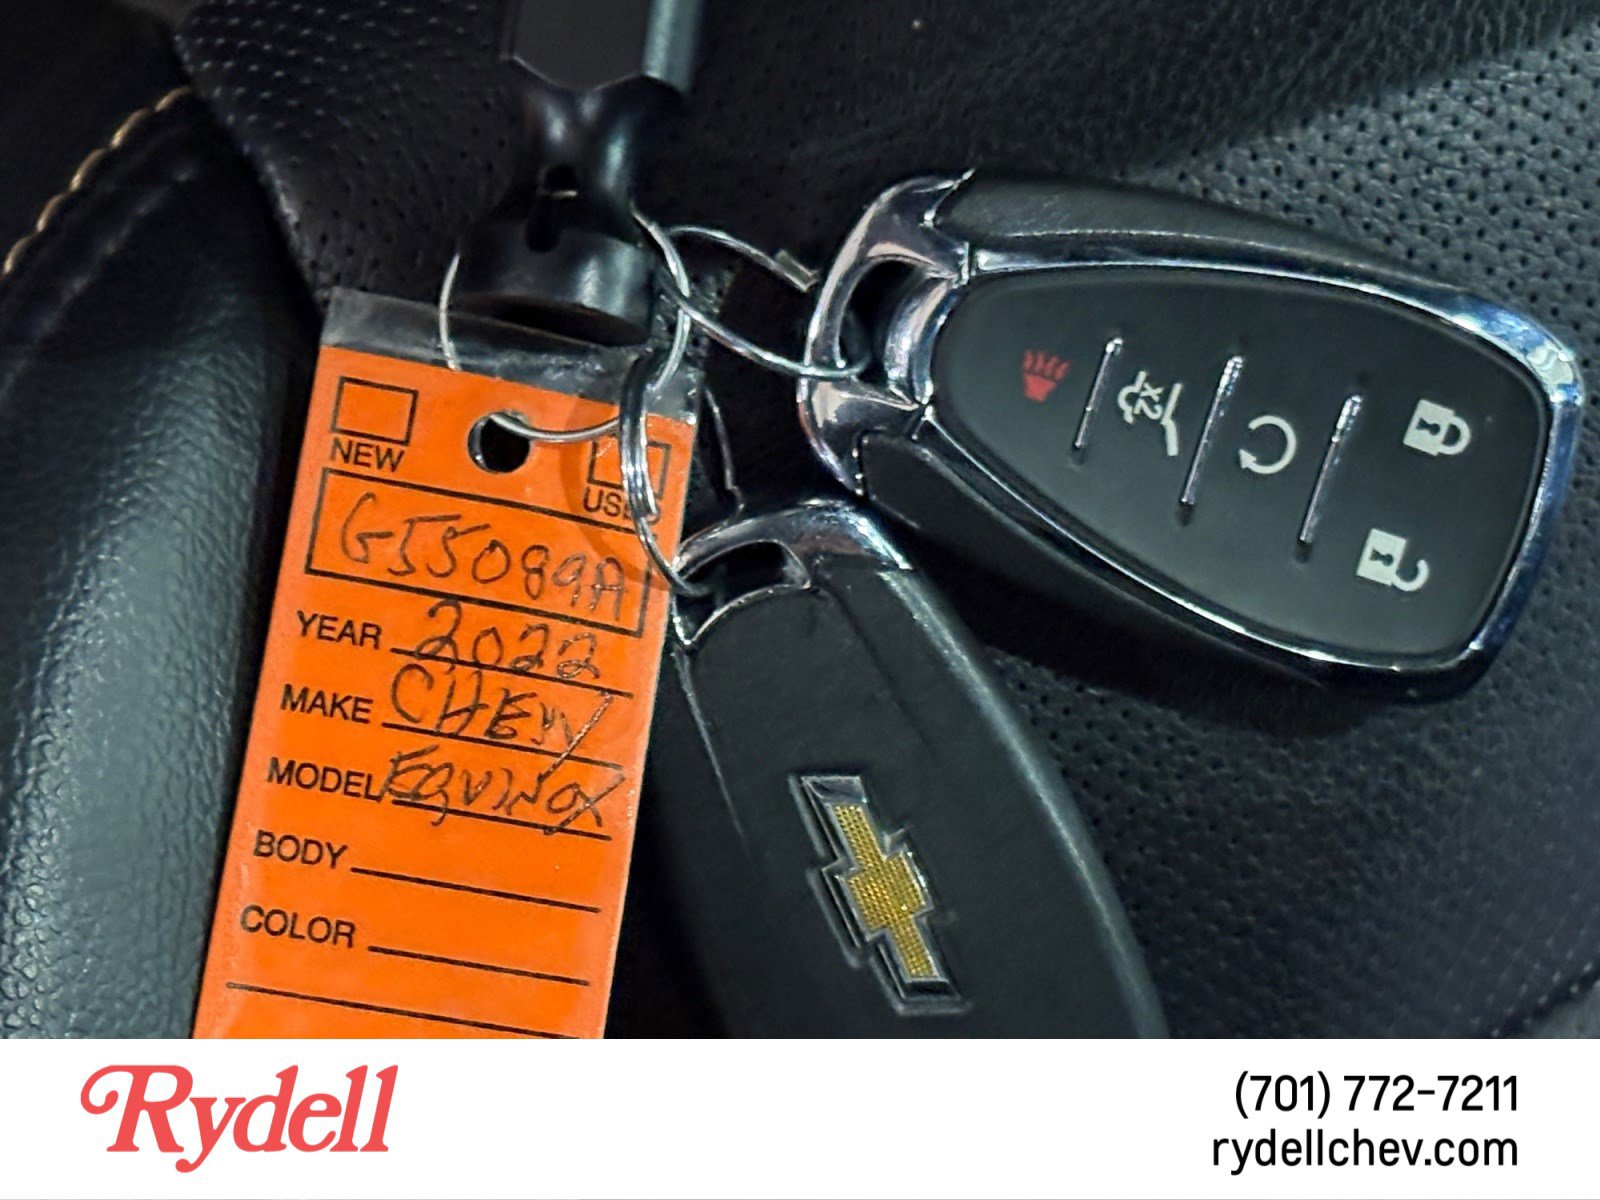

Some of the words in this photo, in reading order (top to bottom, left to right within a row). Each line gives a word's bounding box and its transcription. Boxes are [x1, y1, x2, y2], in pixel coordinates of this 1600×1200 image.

[331, 437, 404, 473] NEW
[296, 609, 383, 650] YEAR
[414, 598, 601, 680] 2022
[279, 683, 374, 725] MAKE
[266, 756, 381, 802] MODEL
[253, 829, 348, 870] BODY
[239, 904, 357, 949] COLOR
